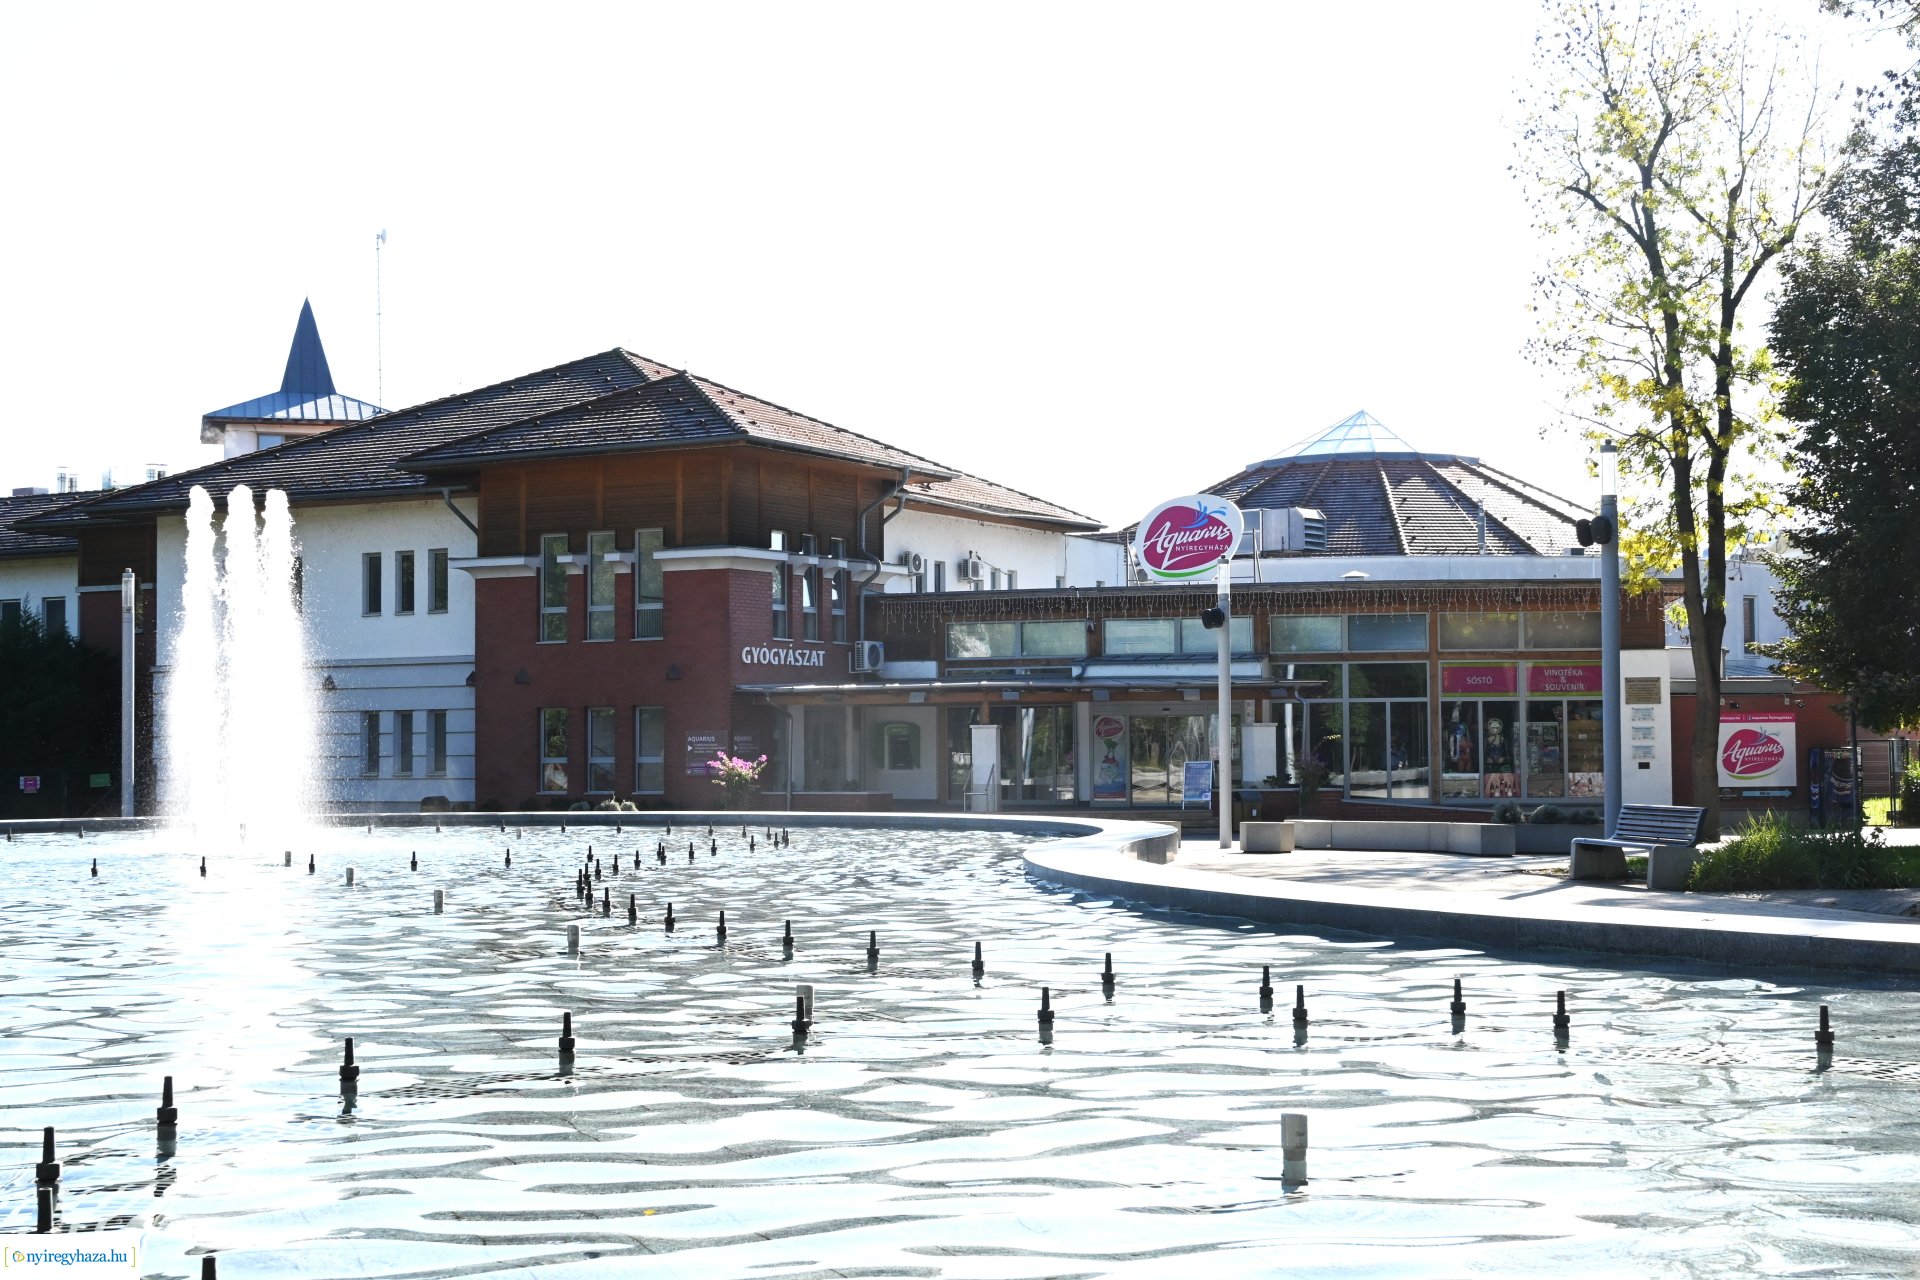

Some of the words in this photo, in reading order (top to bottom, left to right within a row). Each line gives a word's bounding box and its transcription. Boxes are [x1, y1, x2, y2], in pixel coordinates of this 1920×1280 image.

[1143, 521, 1232, 569] Aquarius
[1175, 543, 1229, 552] NYÍREGYHÁZA
[741, 641, 826, 667] GYÓGYÁSZAT
[1544, 667, 1583, 676] VINOTÉKA
[1466, 675, 1493, 685] SÓSTÓ
[1560, 676, 1567, 684] &
[1544, 683, 1585, 691] SOUVENIR
[1721, 740, 1784, 774] Aquarius
